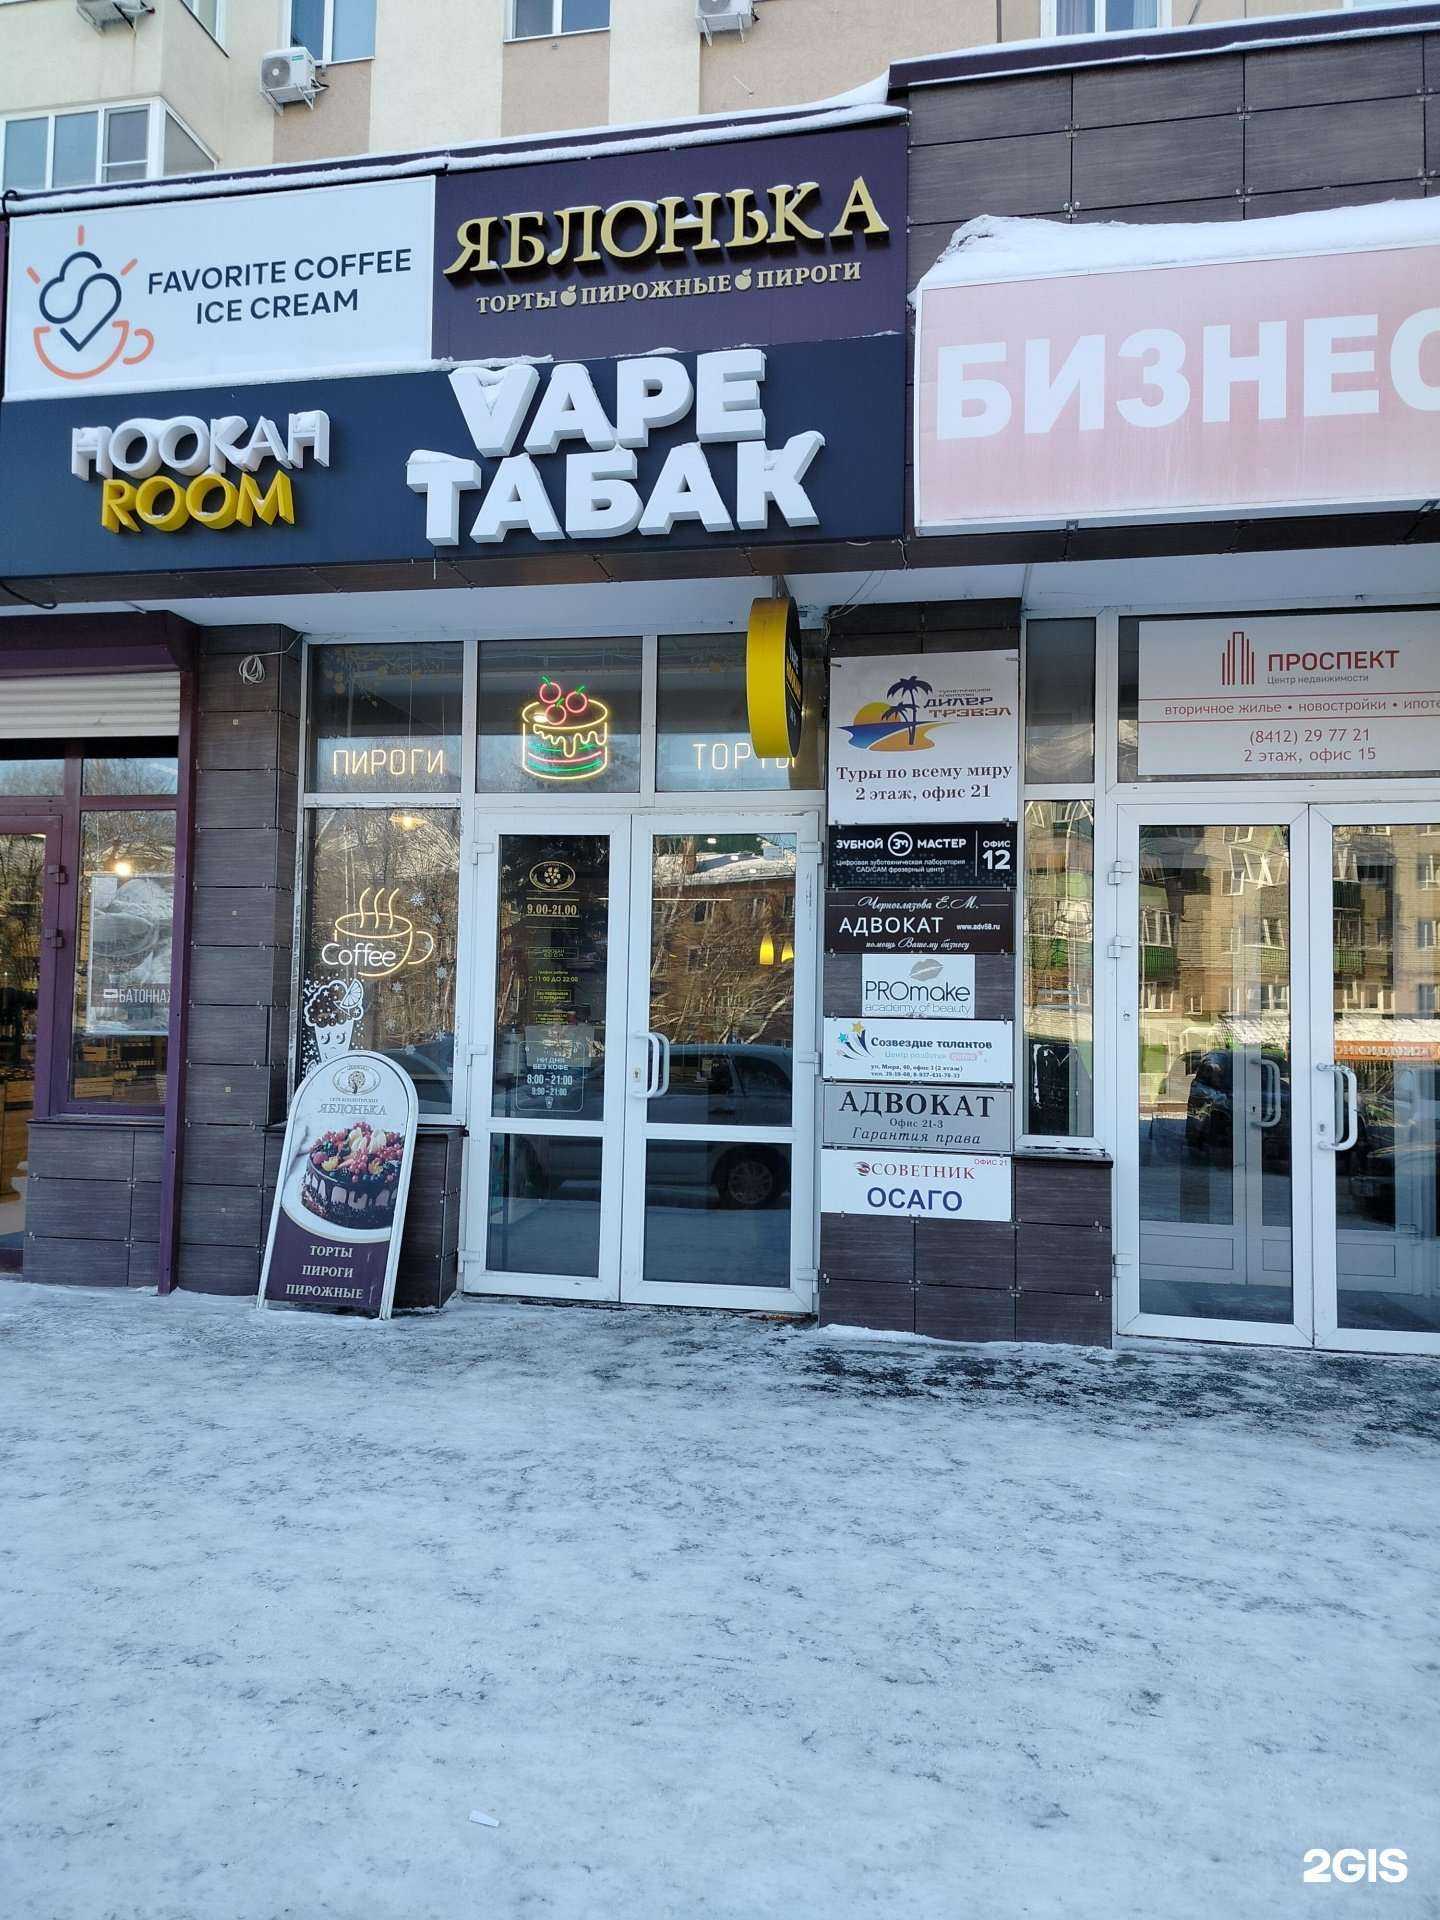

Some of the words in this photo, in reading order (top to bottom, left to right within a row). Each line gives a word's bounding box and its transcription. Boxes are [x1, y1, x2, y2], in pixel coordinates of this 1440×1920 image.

[444, 176, 889, 275] ЯБЛОНЬКА
[148, 259, 286, 294] FAVORITE
[294, 248, 412, 281] COFFEE
[477, 290, 557, 313] ТОРТЫ
[580, 275, 730, 306] ПИРОЖНЫЕ
[756, 262, 861, 289] ПИРОГИ
[196, 298, 242, 325] ICE
[250, 288, 359, 320] CREAM
[448, 348, 767, 458] VAPE
[71, 409, 330, 482] HOOKAH
[406, 430, 826, 546] ТАБАК
[102, 469, 295, 533] ROOM
[1268, 650, 1400, 672] ПРОСПЕКТ
[1267, 675, 1296, 685] Центр
[1298, 674, 1369, 684] недвижимости
[923, 697, 993, 708] ДИЛЕР
[1164, 703, 1234, 717] вторичное
[1238, 703, 1282, 713] жилье
[1298, 698, 1386, 713] новостройки
[1250, 729, 1298, 745] (8412)
[1304, 729, 1322, 742] 29
[1328, 729, 1347, 742] 77
[1352, 728, 1370, 741] 21
[333, 749, 445, 776] ПИРОГИ
[1244, 750, 1252, 762] 2
[1258, 750, 1302, 764] этаж,
[1309, 748, 1352, 764] офис
[1358, 747, 1376, 760] 15
[836, 766, 881, 782] Туры
[886, 768, 907, 779] по
[912, 767, 962, 782] всему
[966, 765, 1012, 780] миру
[855, 787, 866, 801] 2
[870, 788, 916, 802] этаж,
[922, 786, 965, 802] офис
[970, 784, 991, 799] 21
[836, 838, 884, 849] ЗУБНОЙ
[917, 838, 967, 849] МАСТЕР
[982, 840, 1011, 848] ОФИС
[982, 849, 1011, 870] 12
[527, 903, 577, 915] 9.00-21.00
[839, 917, 944, 937] АДВОКАТ
[321, 942, 396, 967] Coffee
[865, 981, 970, 1002] PROmake
[871, 1037, 933, 1049] Созвездие
[937, 1040, 992, 1049] талантов
[318, 1104, 387, 1115] ЯБЛОНЬКА
[838, 1090, 995, 1118] АДВОКАТ
[889, 1117, 918, 1129] Офис
[921, 1119, 944, 1129] 21-3
[852, 1127, 929, 1143] Гарантия
[936, 1133, 981, 1146] права
[871, 1162, 976, 1180] СОВЕТНИК
[867, 1186, 963, 1212] ОСАГО
[309, 1245, 353, 1258] ТОРТЫ
[302, 1264, 353, 1278] ПИРОГИ
[286, 1284, 364, 1299] ПИРОЖНЫЕ
